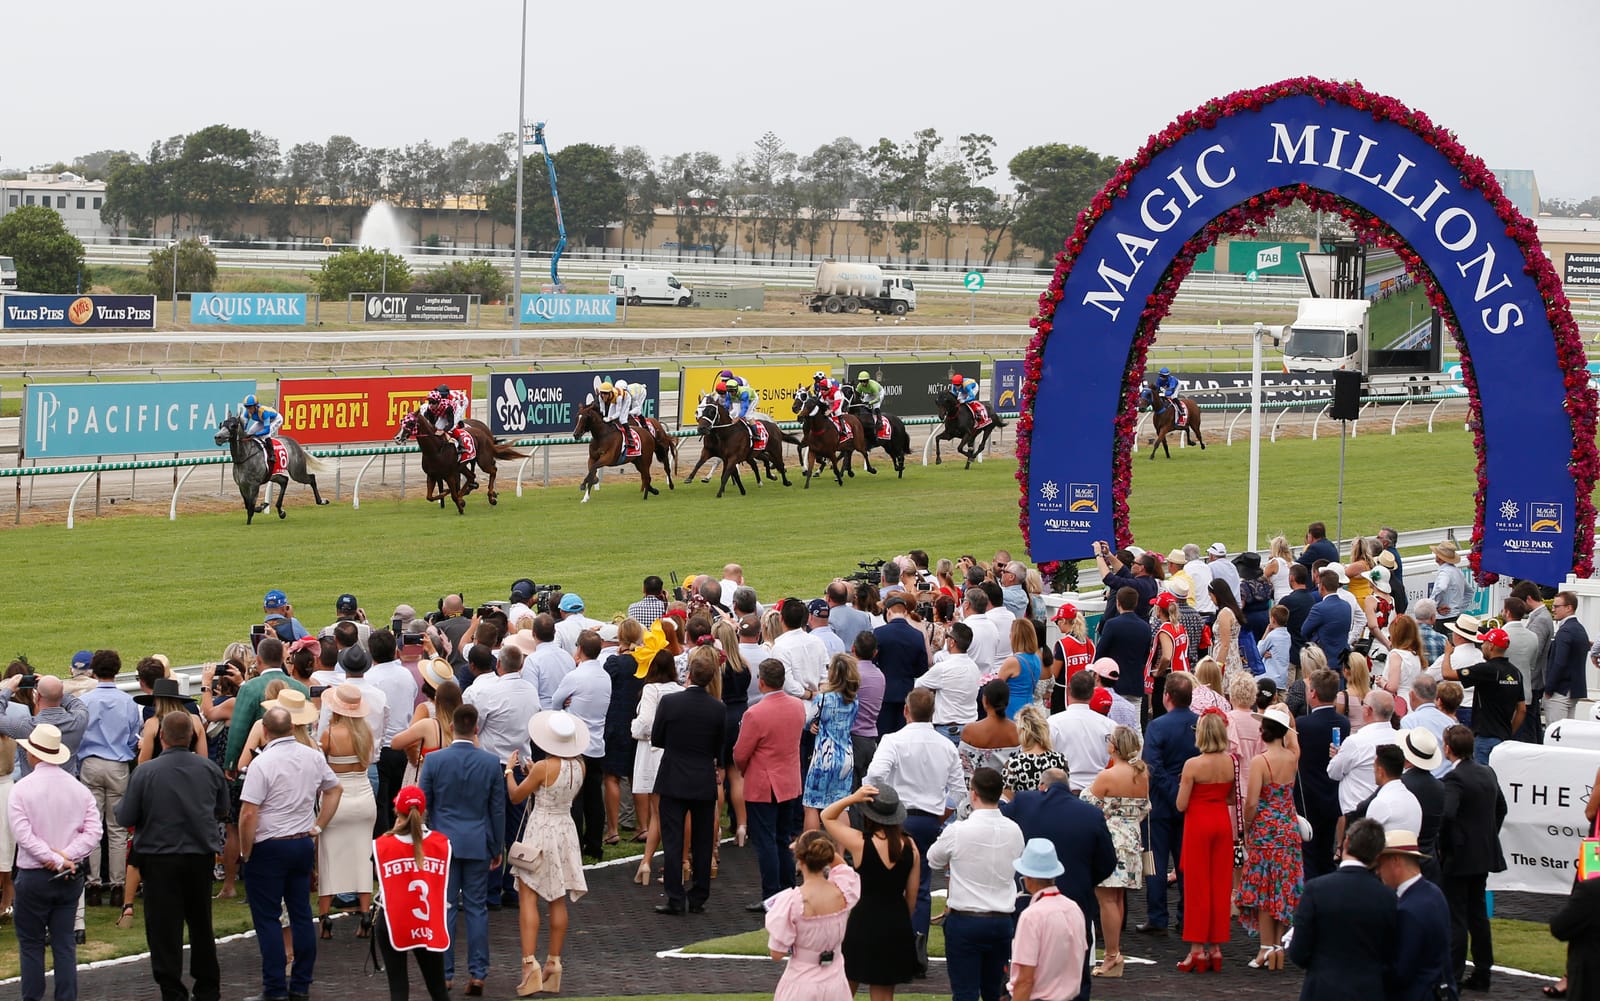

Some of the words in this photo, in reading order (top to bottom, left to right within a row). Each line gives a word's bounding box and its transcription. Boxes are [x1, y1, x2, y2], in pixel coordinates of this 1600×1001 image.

[1082, 144, 1237, 322] MAGIC
[1267, 122, 1525, 335] MILLIONS
[1259, 254, 1279, 263] TAB
[967, 274, 981, 290] 2
[1248, 271, 1257, 281] 4
[39, 306, 64, 320] PIES
[127, 306, 151, 320] PIES
[198, 295, 252, 321] AQUIS
[256, 297, 300, 316] PARK
[382, 296, 408, 314] CITY
[525, 297, 571, 320] AQUIS
[575, 299, 611, 316] PARK
[527, 387, 563, 403] RACING
[67, 404, 180, 435] PACIFIC
[282, 393, 369, 431] Ferrari
[500, 404, 524, 427] SKY
[526, 402, 571, 426] ACTIVE
[463, 436, 474, 454] 3
[278, 450, 287, 469] 6
[1045, 519, 1069, 529] AQUIS
[1070, 520, 1091, 528] PARK
[1503, 539, 1529, 549] AQUIS
[1550, 726, 1562, 742] 4
[1509, 783, 1571, 808] THE
[1547, 825, 1586, 838] GOL
[1511, 853, 1537, 866] The
[1540, 856, 1569, 870] Star
[408, 879, 430, 921] 3
